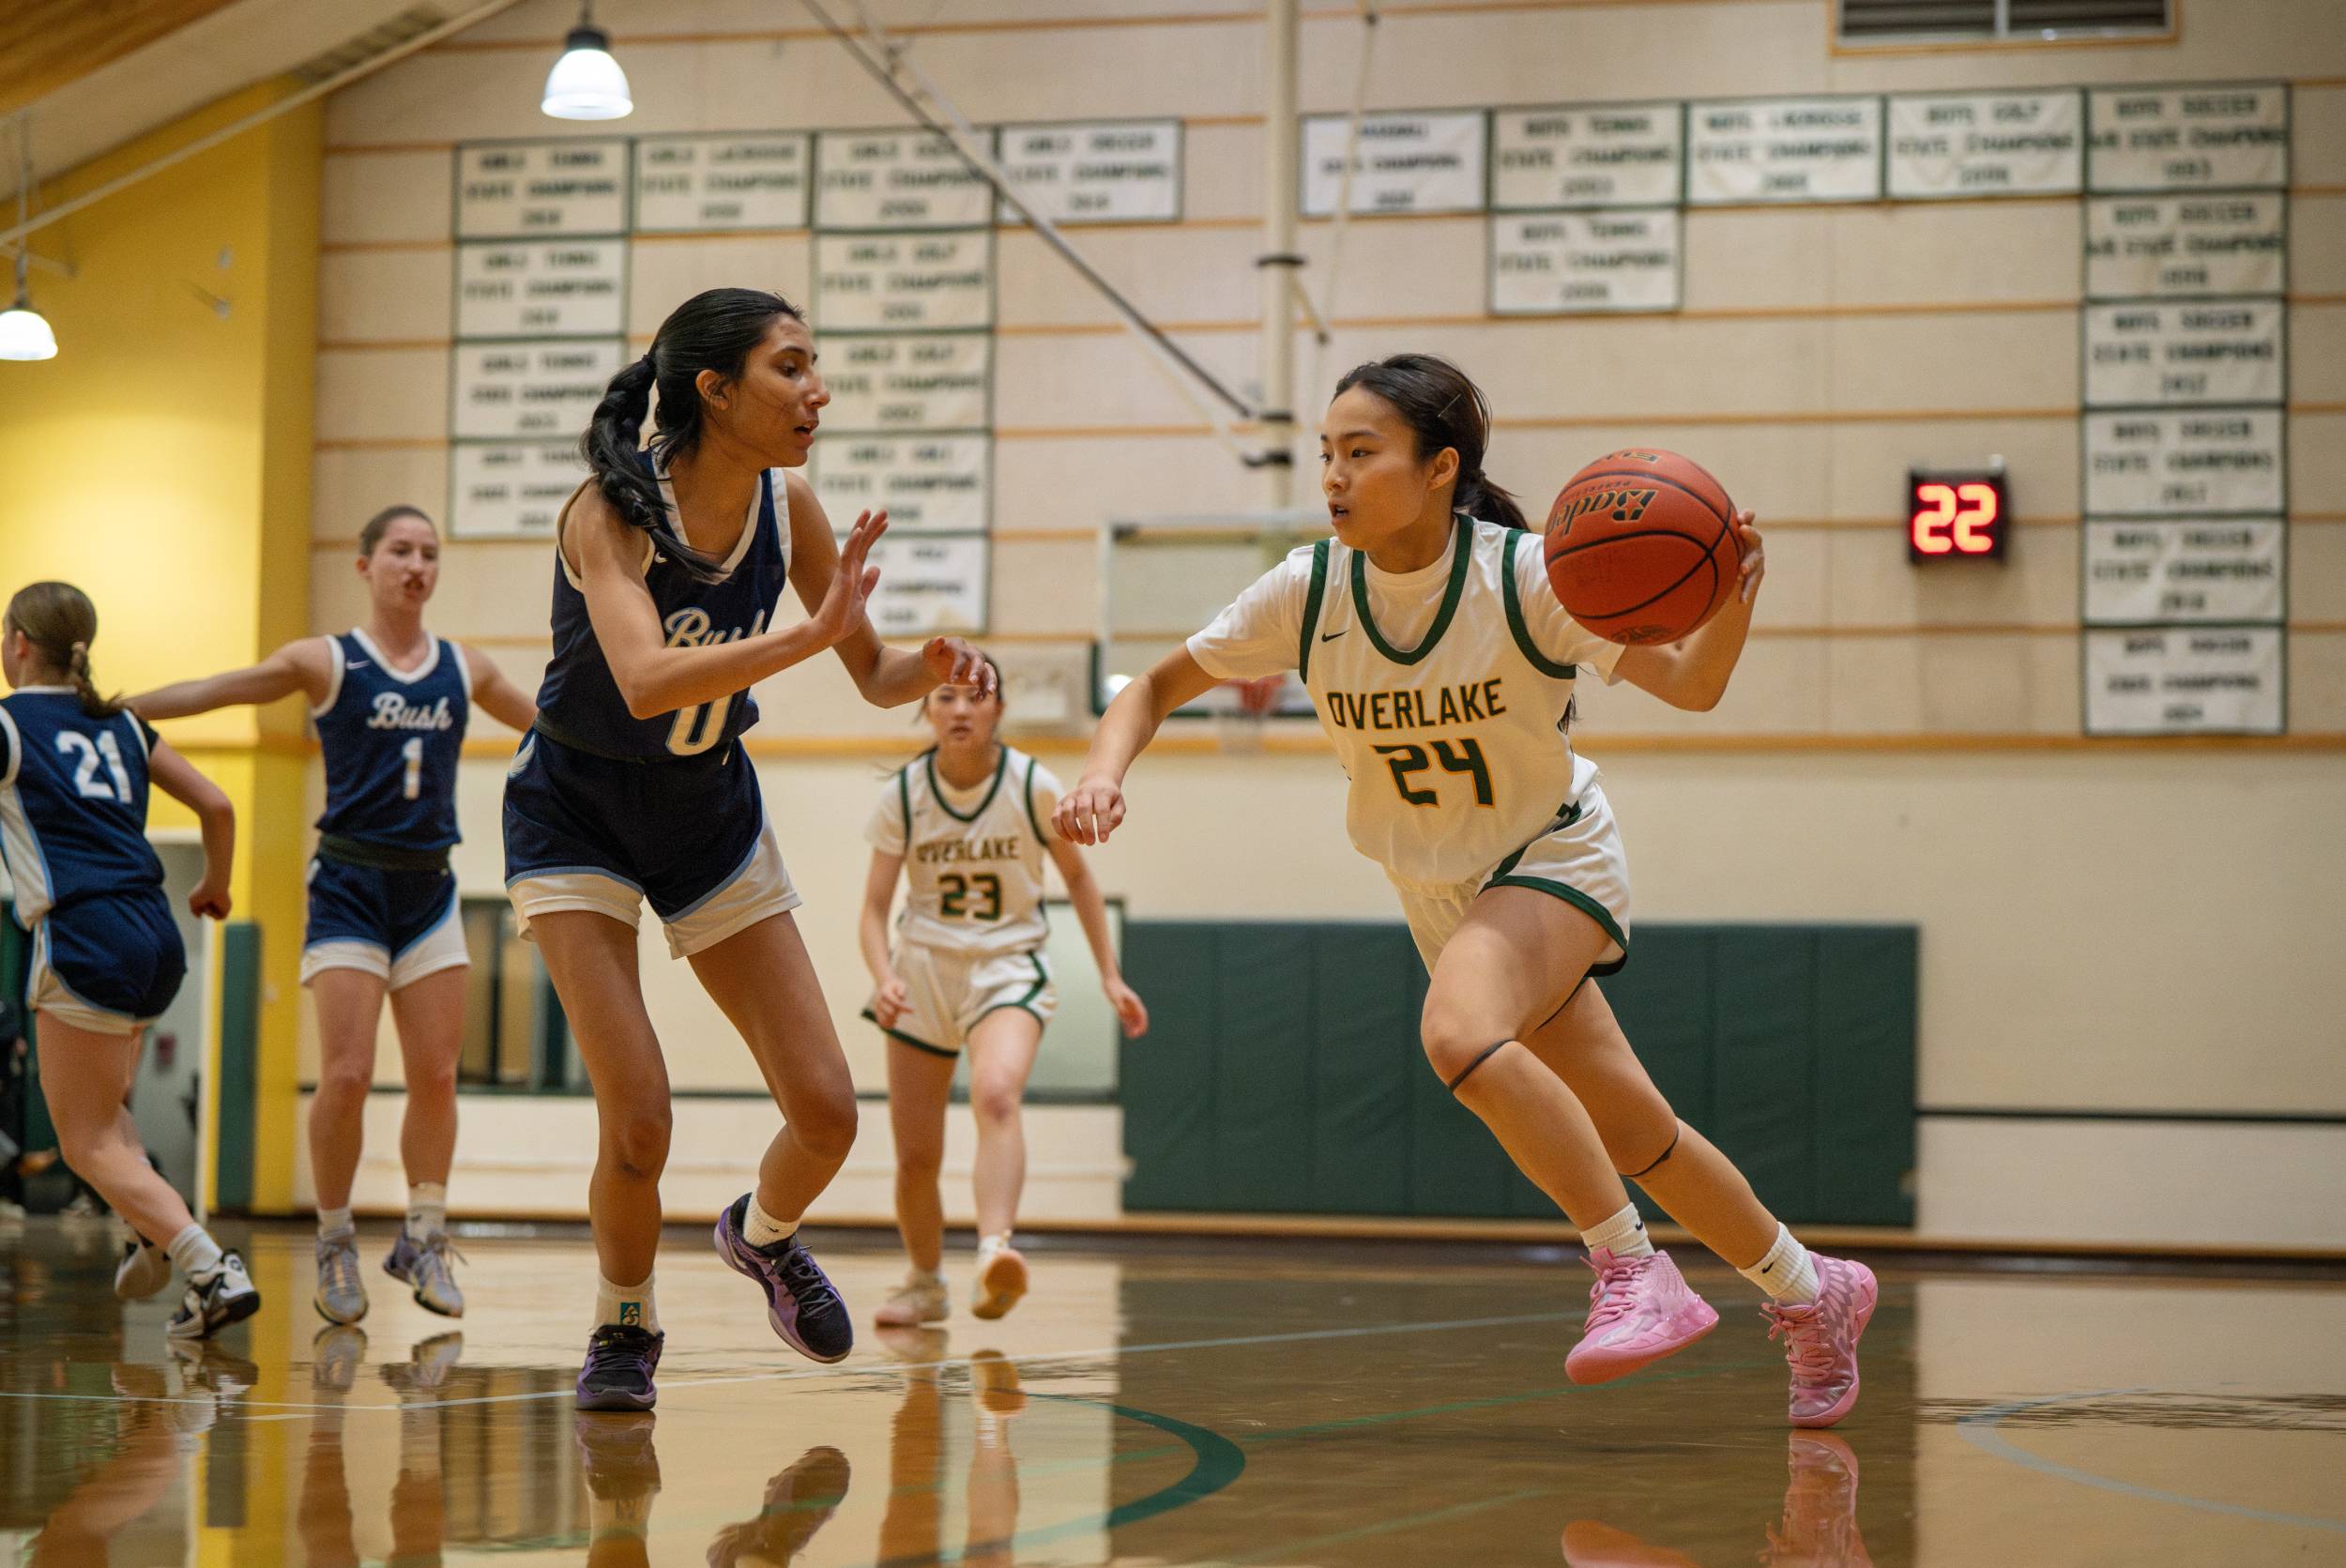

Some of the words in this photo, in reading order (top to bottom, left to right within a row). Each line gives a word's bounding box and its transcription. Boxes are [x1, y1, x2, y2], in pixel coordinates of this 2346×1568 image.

[1912, 482, 1998, 554] 22
[366, 691, 454, 732] Bush
[664, 694, 733, 756] 0
[1327, 677, 1507, 730] OVERLAKE
[53, 729, 133, 804] 21
[401, 735, 423, 800] 1
[1369, 737, 1496, 809] 24
[939, 874, 1001, 921] 23
